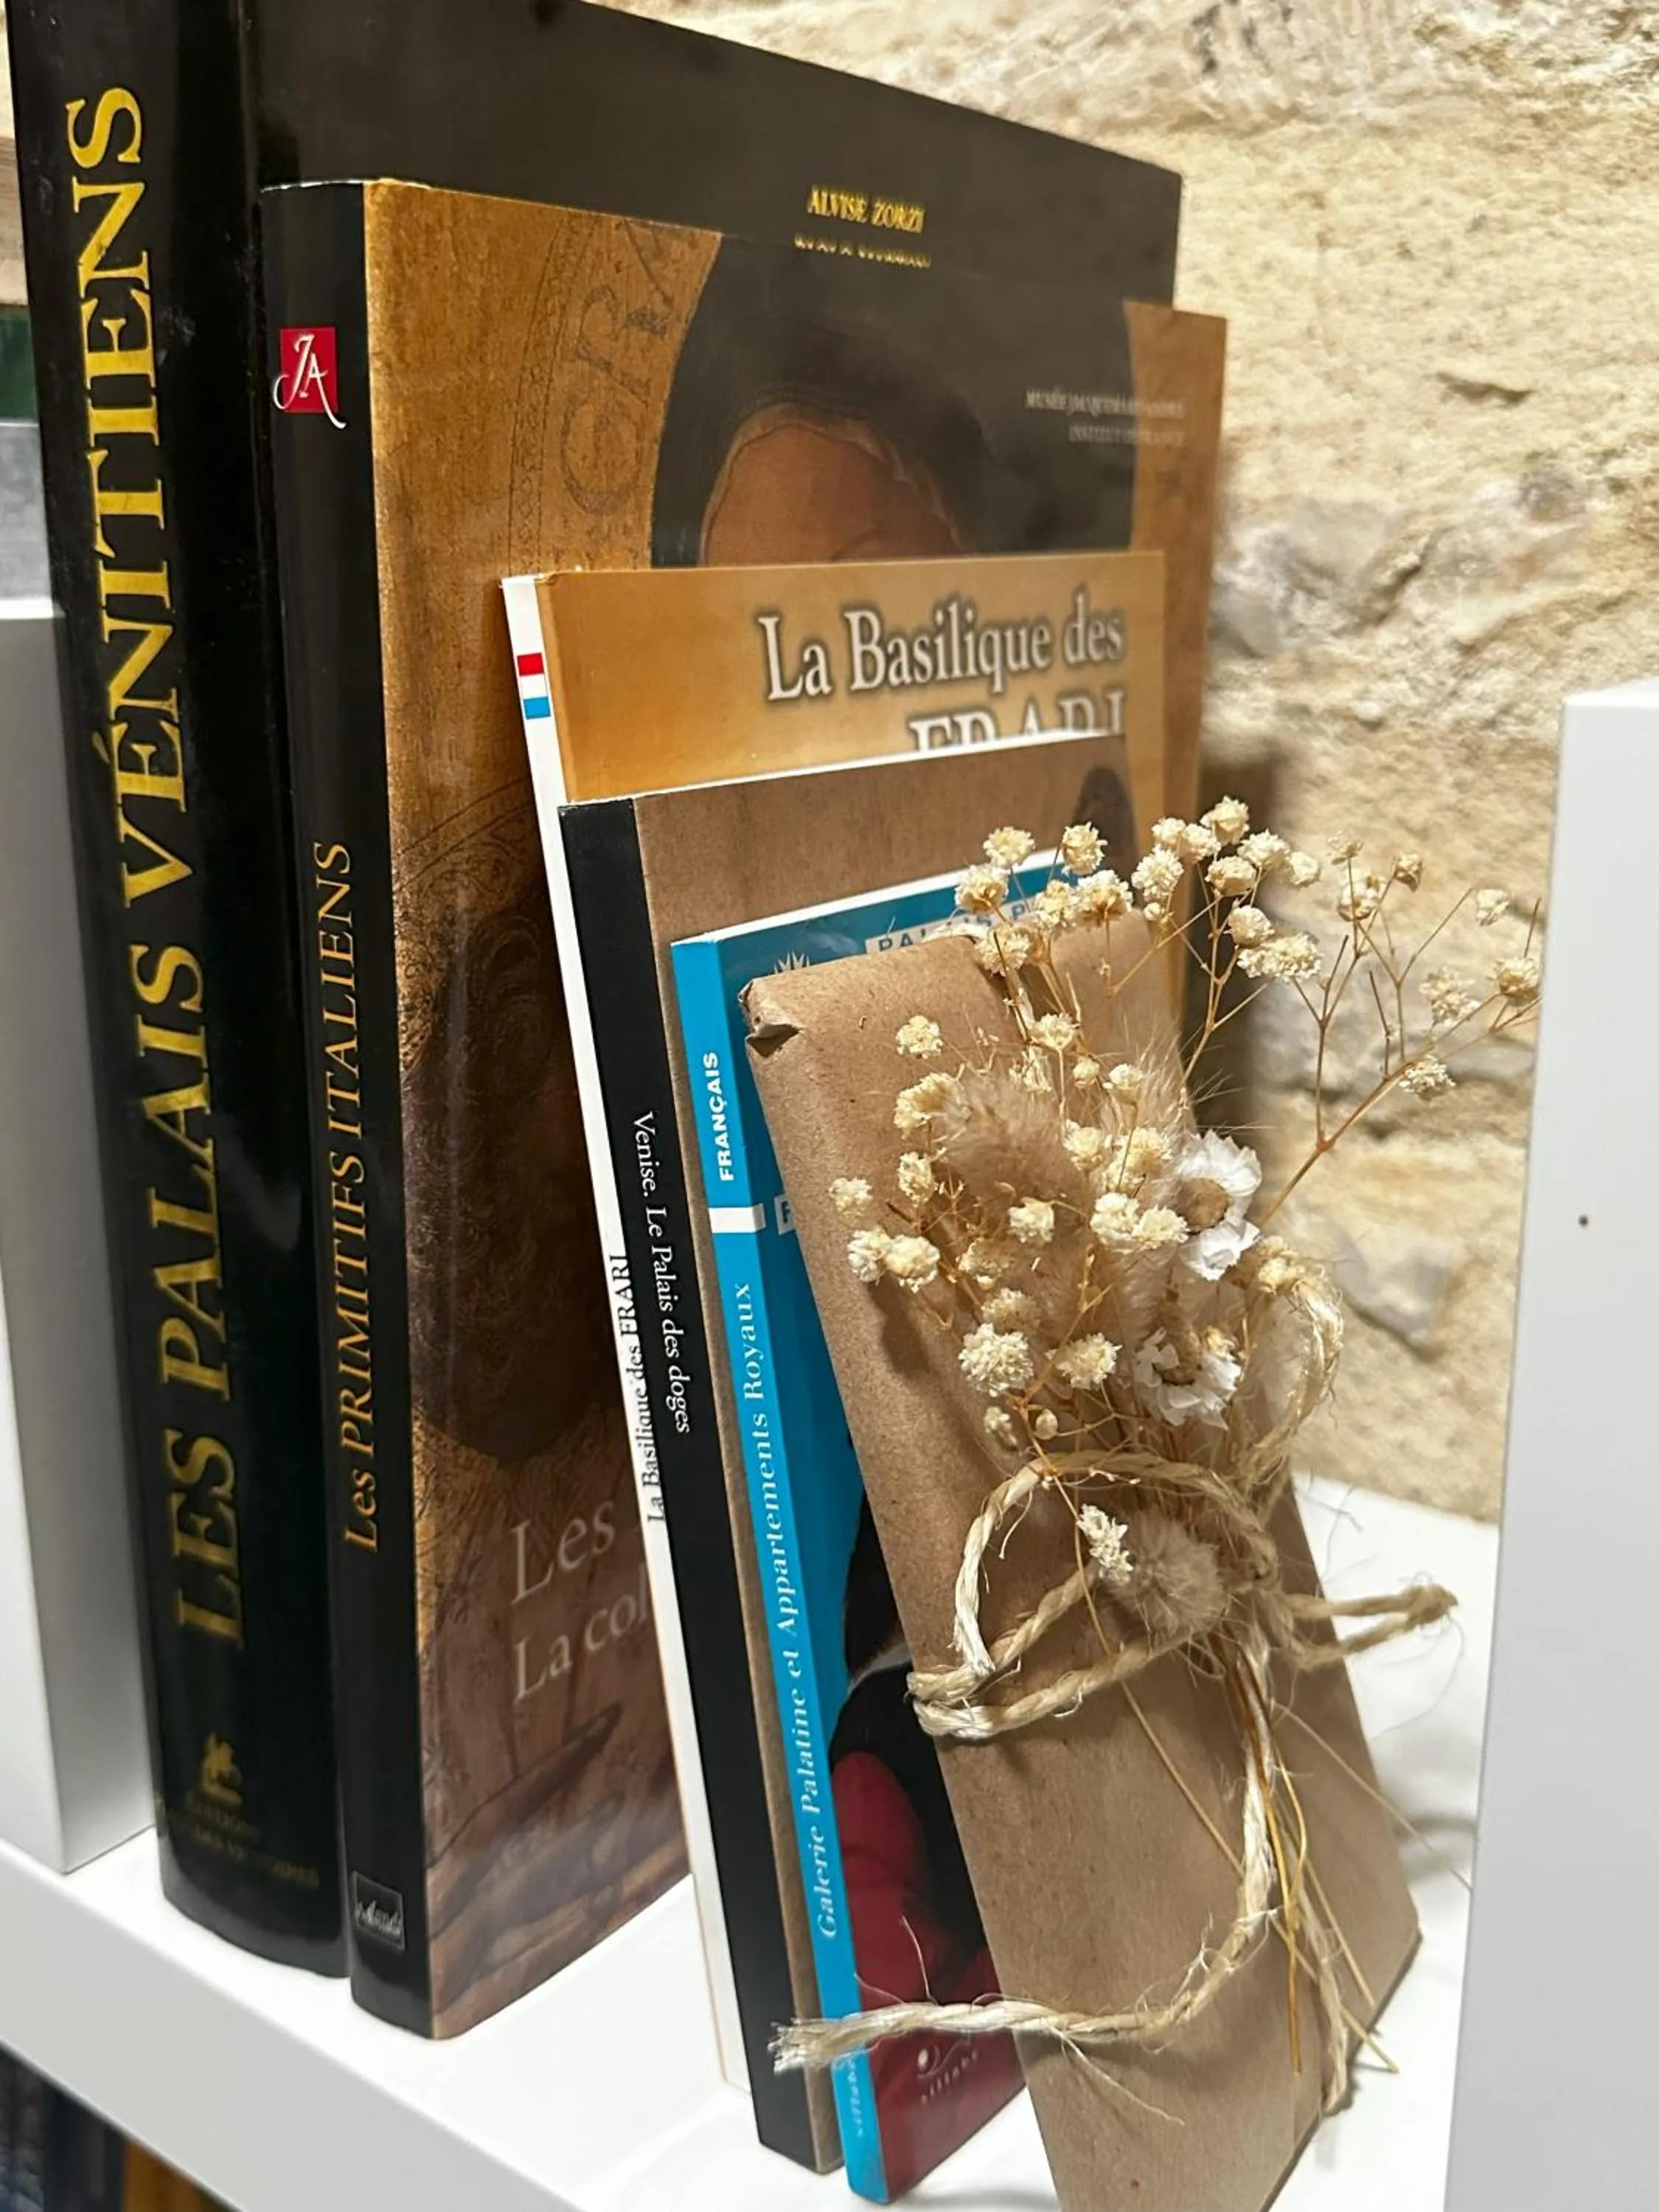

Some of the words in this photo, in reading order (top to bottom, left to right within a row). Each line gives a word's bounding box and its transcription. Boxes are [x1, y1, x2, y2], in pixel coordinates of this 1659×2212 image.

[66, 87, 193, 908] VÉNITIENS
[758, 615, 832, 700] La
[844, 601, 1051, 692] Basilique
[1064, 594, 1124, 664] des
[314, 842, 361, 1140] ITALIENS
[633, 1110, 660, 1197] Venise.
[703, 1052, 734, 1181] FRANÇAIS
[129, 944, 230, 1400] PALAIS
[645, 1206, 667, 1237] Le
[330, 1150, 375, 1458] PRIMITIFS
[609, 1253, 639, 1337] FRARI
[651, 1245, 678, 1312] Palais
[625, 1345, 644, 1381] des
[662, 1318, 684, 1359] des
[734, 1283, 765, 1399] Royaux
[665, 1365, 690, 1434] doges
[165, 1429, 244, 1650] LES
[344, 1468, 378, 1552] Les
[510, 1500, 615, 1604] Les
[647, 1494, 664, 1523] La
[752, 1413, 799, 1636] Appartements
[513, 1633, 572, 1705] La
[584, 1562, 649, 1652] col
[782, 1650, 801, 1677] et
[790, 1688, 821, 1814] Palatine
[808, 1826, 836, 1938] Galerie
